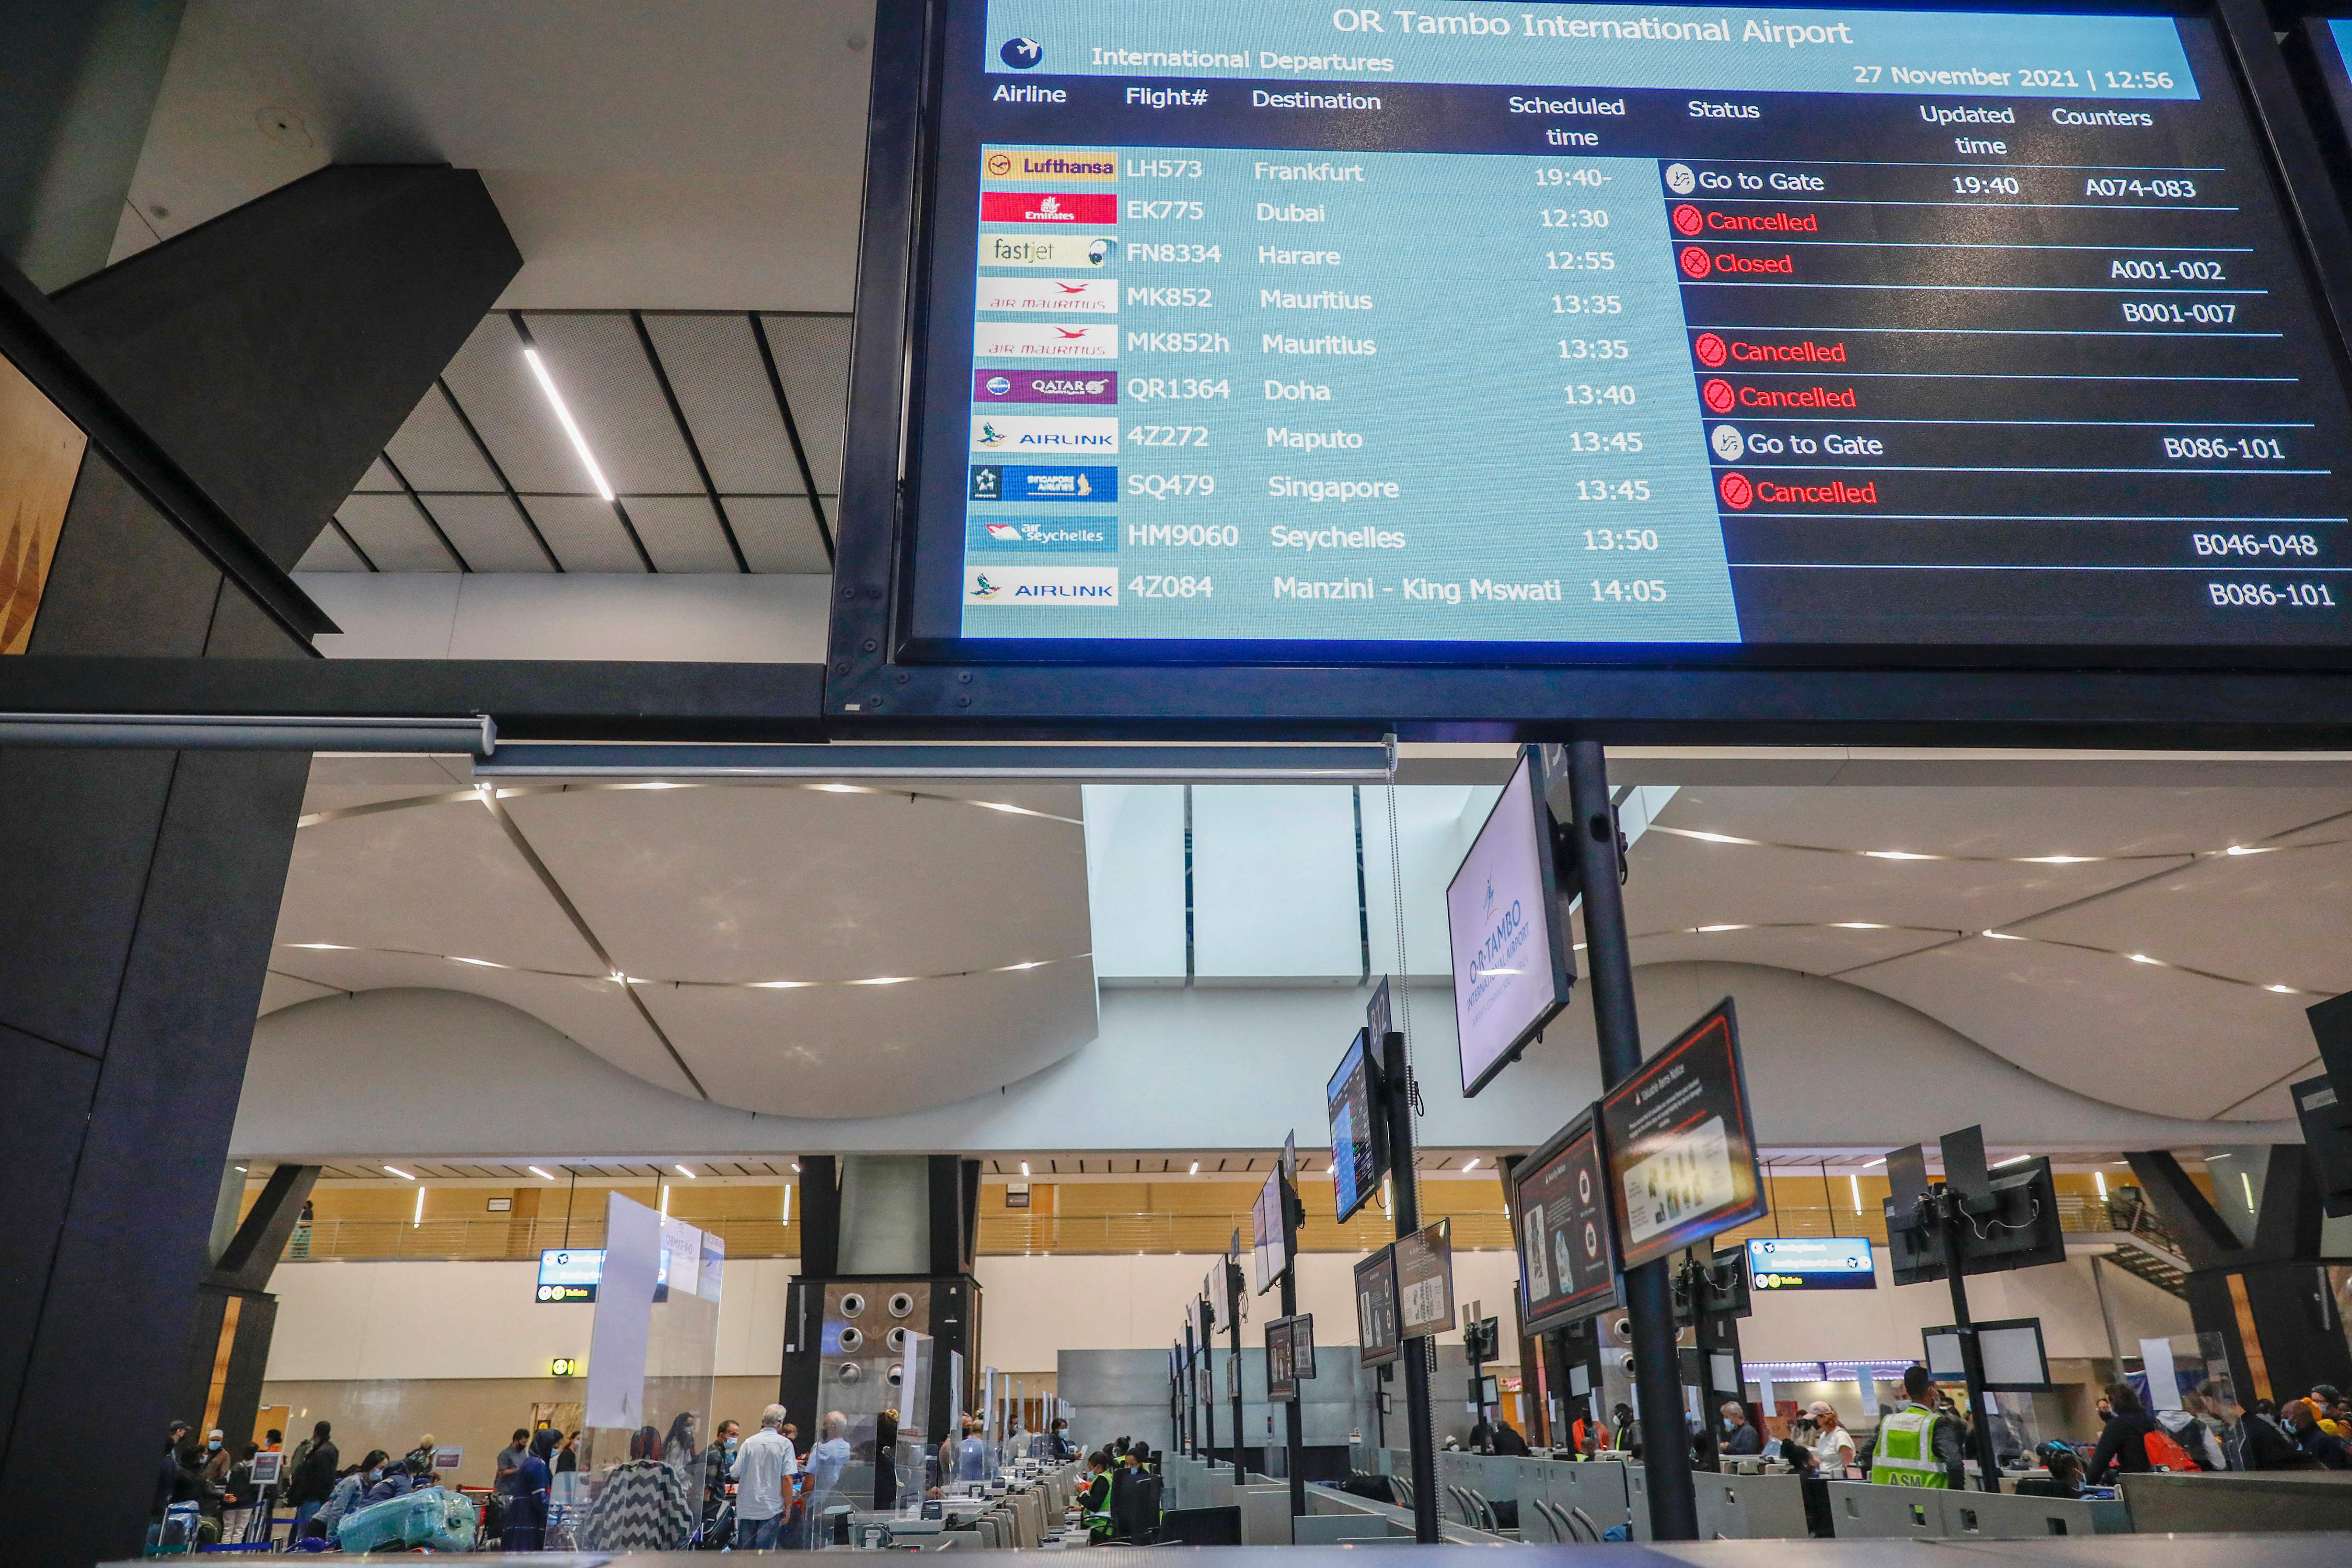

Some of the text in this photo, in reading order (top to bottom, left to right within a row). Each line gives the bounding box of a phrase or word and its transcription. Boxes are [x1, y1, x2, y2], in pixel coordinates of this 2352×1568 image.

[1333, 9, 1853, 48] OR Tambo International Airport
[1092, 48, 1394, 73] International Departures
[1853, 66, 1882, 83] 27
[1891, 67, 2011, 85] November
[2019, 70, 2079, 87] 2021
[2105, 71, 2173, 88] 12:56
[993, 85, 1066, 102] Airline
[1127, 88, 1208, 108] Flight#
[1253, 90, 1381, 109] Destination
[1509, 97, 1625, 115] Scheduled
[1689, 101, 1760, 118] Status
[1920, 106, 2015, 125] Updated
[2052, 109, 2153, 126] Counters
[1546, 129, 1598, 146] time
[1955, 137, 2007, 154] time
[1025, 159, 1113, 174] Lufthansa
[1127, 159, 1202, 178] LH573
[1255, 162, 1364, 181] Frankfurt
[1536, 168, 1612, 186] 19:40-
[1699, 172, 1824, 191] Go to Gate
[1953, 177, 2019, 194] 19:40
[2086, 179, 2196, 197] A074-083
[1025, 210, 1074, 221] Emirates
[1127, 201, 1203, 220] EK775
[1257, 203, 1324, 222] Dubai
[1541, 209, 1608, 227] 12:30
[1707, 212, 1818, 232] Cancelled
[995, 238, 1052, 263] fastjet
[1128, 244, 1221, 262] FN8334
[1259, 246, 1341, 265] Harare
[1547, 251, 1615, 270] 12:55
[1714, 253, 1793, 273] Closed
[2112, 261, 2225, 280] A001-002
[1128, 287, 1212, 307] MK852
[1261, 290, 1373, 309] Mauritius
[1552, 295, 1621, 314] 13:35
[2123, 304, 2235, 322] B001-007
[1128, 332, 1229, 352] MK852h
[1263, 335, 1376, 355] Mauritius
[1558, 340, 1628, 359] 13:35
[1731, 342, 1847, 362] Cancelled
[1032, 379, 1084, 393] QATAR
[1128, 378, 1230, 402] QR1364
[1265, 380, 1330, 400] Doha
[1564, 385, 1635, 405] 13:40
[1739, 387, 1857, 408] Cancelled
[1020, 435, 1112, 445] AIRLINK
[1127, 426, 1208, 446] 4Z272
[1267, 428, 1363, 452] Maputo
[1570, 432, 1642, 452] 13:45
[1748, 434, 1883, 455] Go to Gate
[2164, 438, 2285, 458] B086-101
[1128, 475, 1214, 500] SQ479
[1269, 476, 1399, 502] Singapore
[1576, 480, 1650, 500] 13:45
[1757, 481, 1877, 503] Cancelled
[1022, 523, 1041, 533] air
[1028, 528, 1103, 543] seychelles
[1129, 525, 1238, 546] HM9060
[1271, 526, 1405, 551] Seychelles
[1584, 529, 1658, 550] 13:50
[2193, 535, 2318, 555] B046-048
[1015, 586, 1112, 596] AIRLINK
[1128, 575, 1214, 597] 4Z084
[1274, 577, 1374, 598] Manzini
[1403, 578, 1460, 604] King
[1470, 579, 1561, 601] Mswati
[1591, 580, 1666, 601] 14:05
[2209, 584, 2335, 606] B086-101
[1507, 921, 1529, 959] AIRPORT
[1371, 993, 1387, 1045] B12
[1889, 1473, 1922, 1488] ASM
